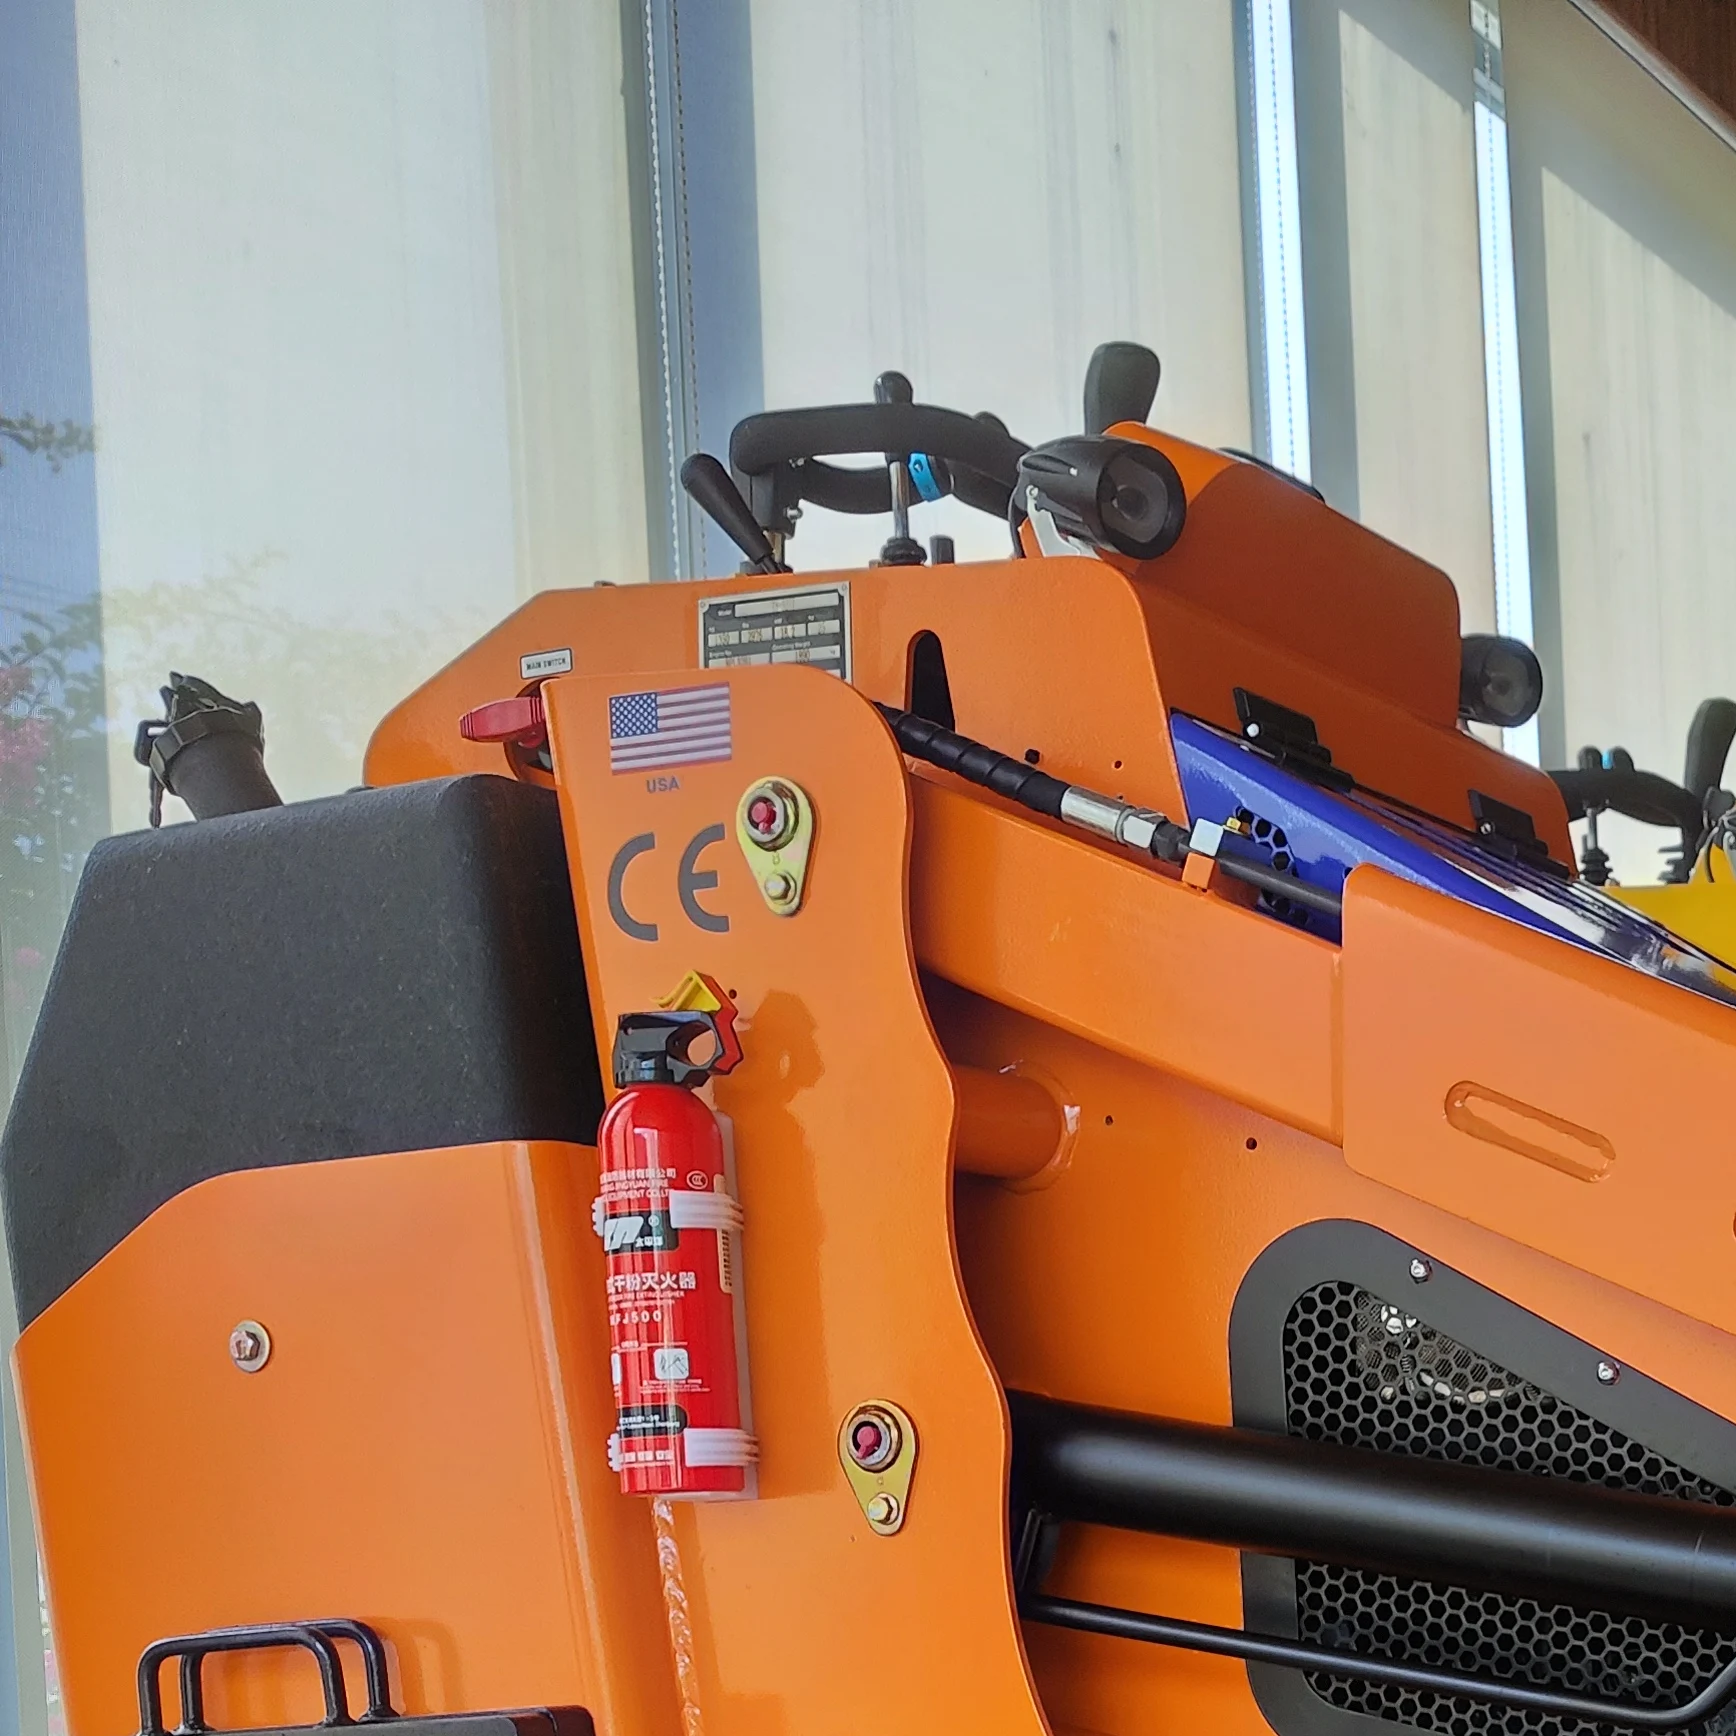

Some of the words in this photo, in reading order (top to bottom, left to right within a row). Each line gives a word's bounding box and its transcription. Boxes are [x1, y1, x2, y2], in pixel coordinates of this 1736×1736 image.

[526, 661, 541, 671] MAIN
[543, 657, 566, 668] SWITCH
[646, 776, 680, 794] USA
[607, 822, 730, 942] CE
